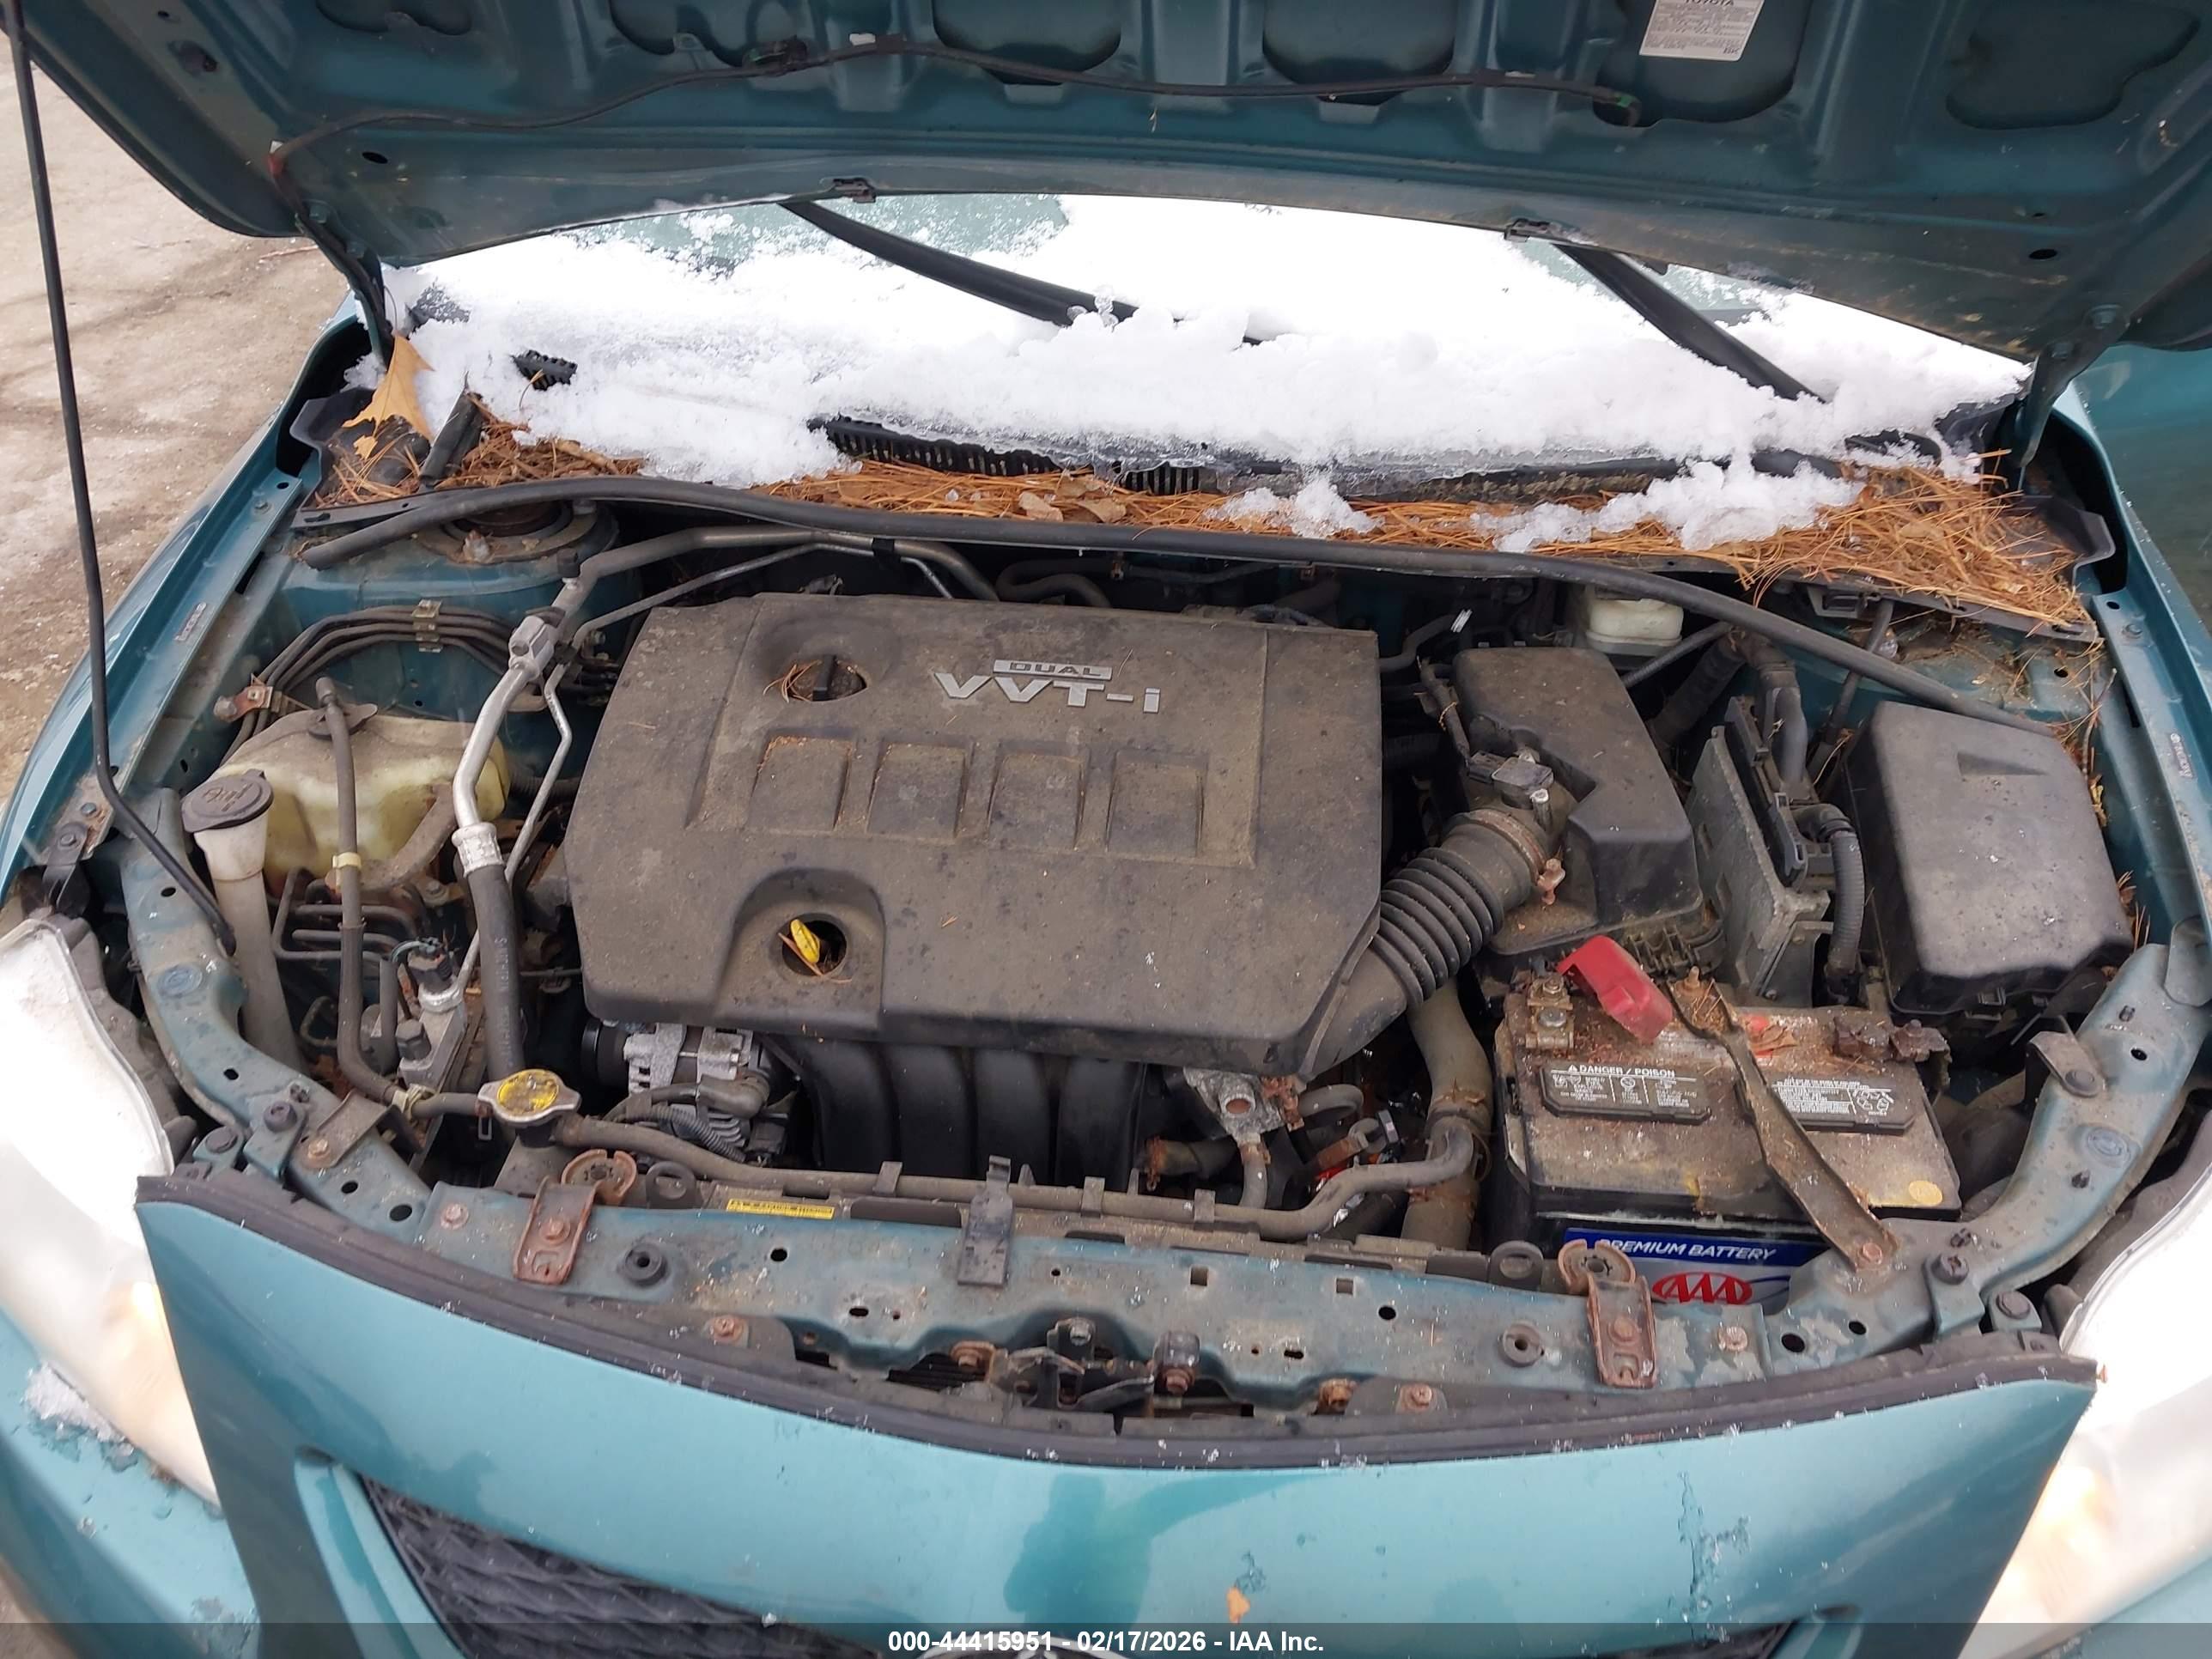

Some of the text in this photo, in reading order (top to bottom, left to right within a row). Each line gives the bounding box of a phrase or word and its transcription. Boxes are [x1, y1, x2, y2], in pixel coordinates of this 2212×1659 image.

[1009, 662, 1101, 677] DUAL
[1579, 1065, 1623, 1075] DANGER
[1635, 1068, 1675, 1077] POISON
[1688, 1244, 1777, 1261] BATTERY
